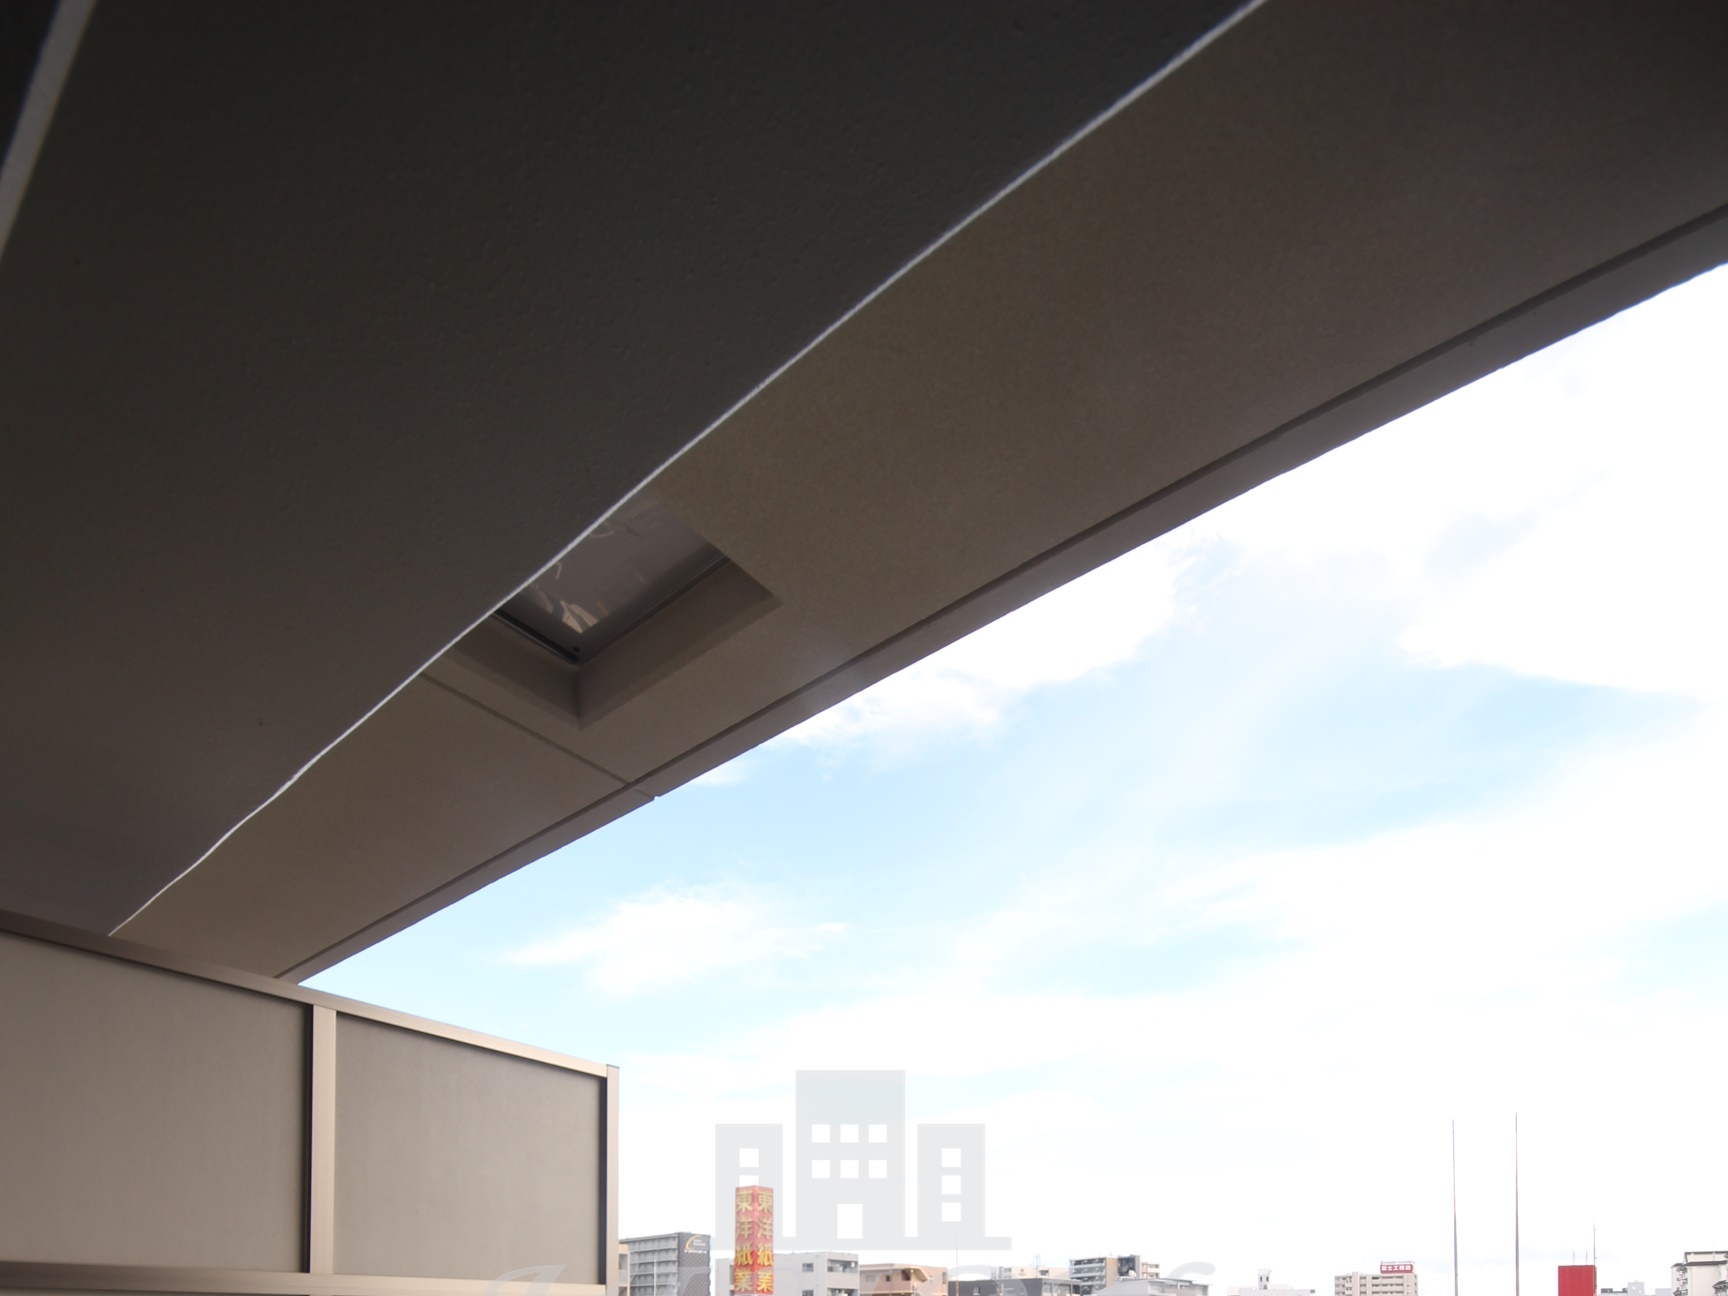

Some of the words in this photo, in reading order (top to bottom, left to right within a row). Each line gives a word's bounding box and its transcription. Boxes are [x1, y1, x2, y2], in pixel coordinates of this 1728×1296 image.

[735, 1190, 754, 1293] 東洋紙業
[757, 1190, 774, 1293] 東洋紙業
